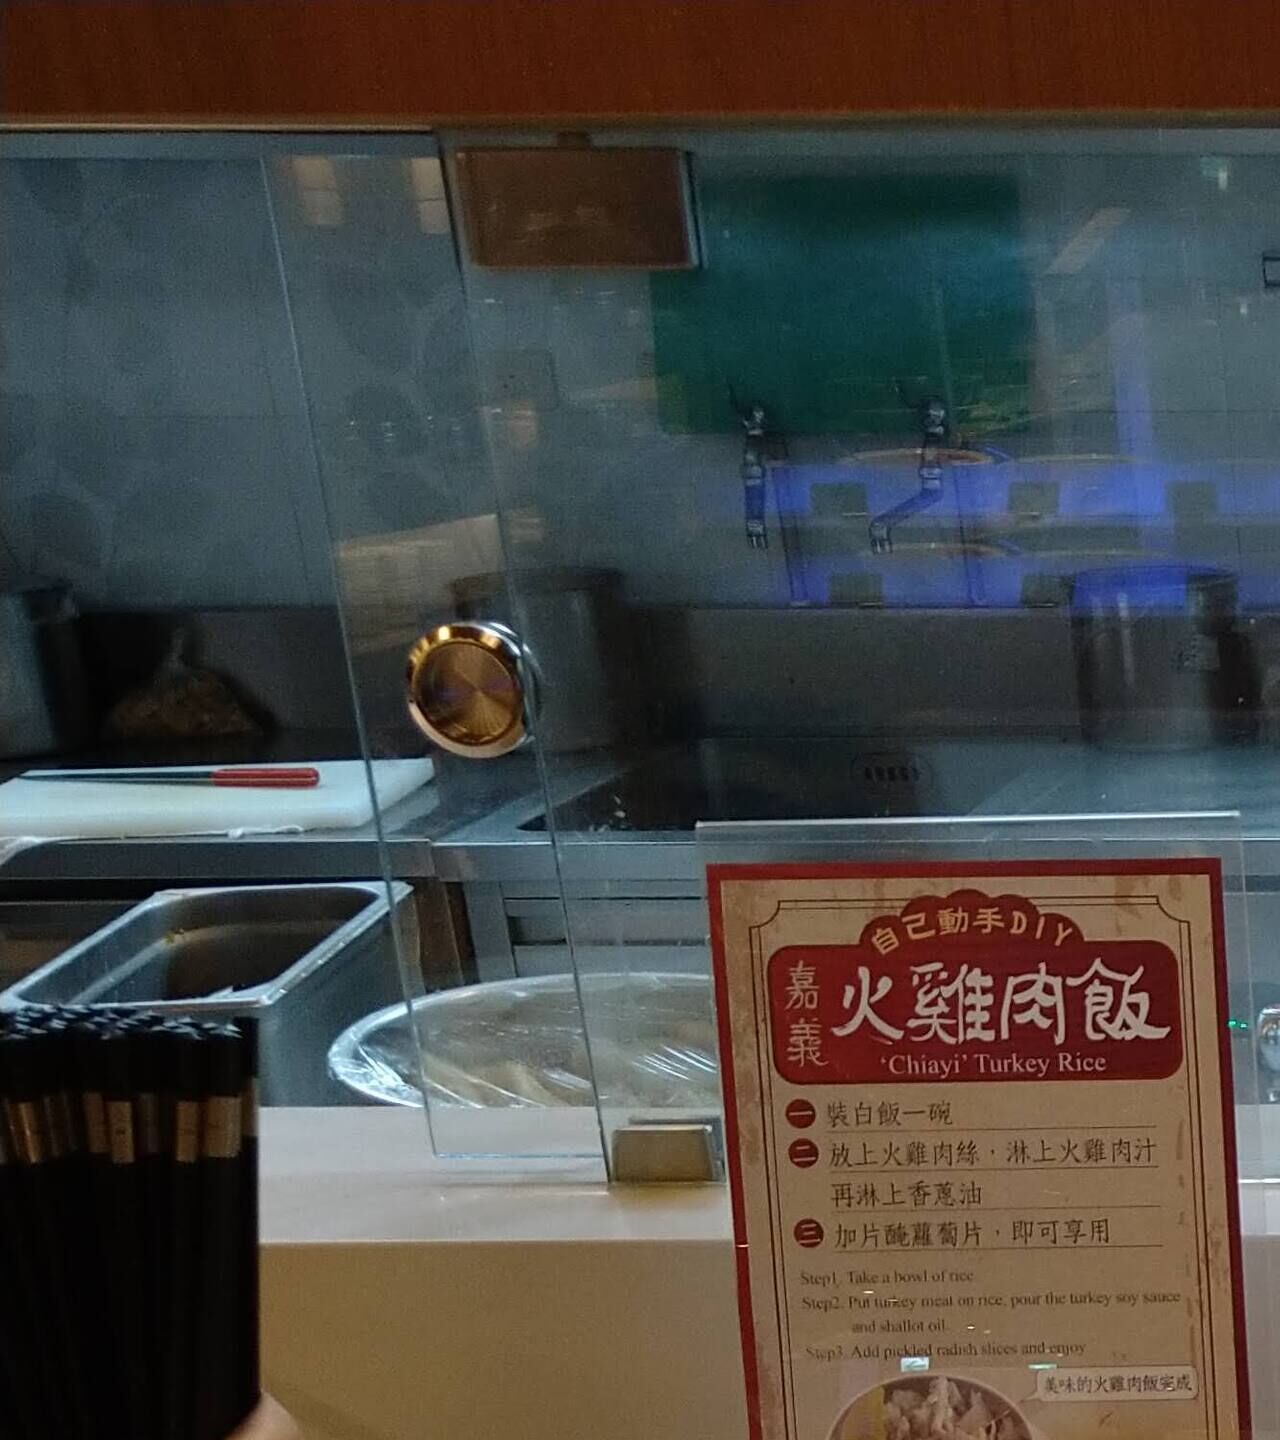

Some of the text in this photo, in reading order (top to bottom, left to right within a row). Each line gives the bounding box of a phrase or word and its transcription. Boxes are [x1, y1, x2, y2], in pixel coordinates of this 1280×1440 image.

[872, 906, 1074, 955] 自己動手DIY
[785, 959, 828, 1068] 嘉義
[831, 957, 1171, 1046] 火雞肉飯
[974, 1053, 1049, 1078] Turkey
[1057, 1052, 1107, 1073] Rice
[826, 1101, 953, 1128] 裝白飯一碗
[847, 1269, 879, 1284] Take
[894, 1269, 928, 1283] bowl
[931, 1269, 947, 1282] of
[1010, 1295, 1045, 1309] pour
[1045, 1291, 1067, 1305] the
[1070, 1291, 1114, 1307] turkey
[852, 1320, 876, 1334] and
[880, 1319, 924, 1333] shallot
[851, 1345, 879, 1359] Add
[884, 1343, 932, 1360] pickled
[1022, 1341, 1045, 1354] and
